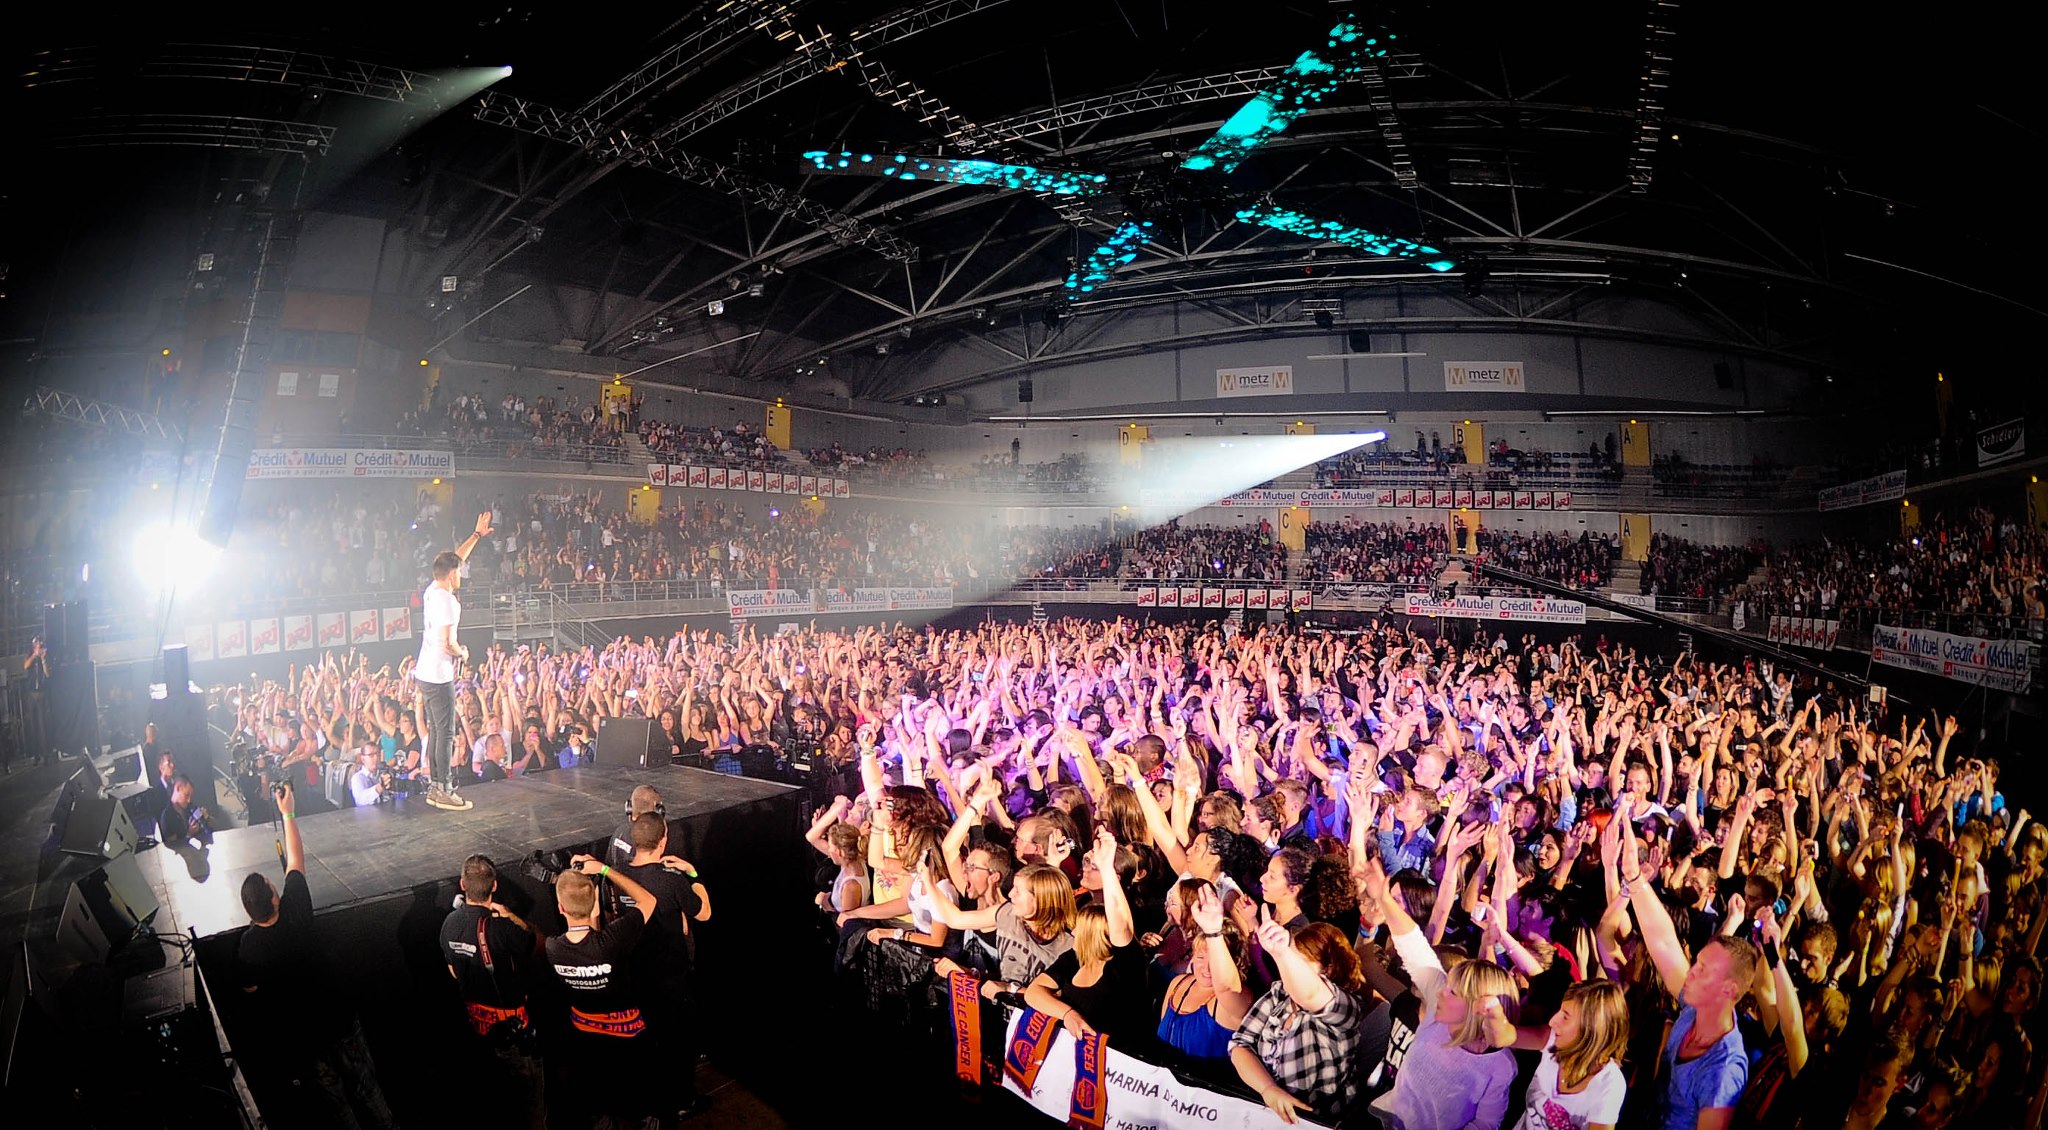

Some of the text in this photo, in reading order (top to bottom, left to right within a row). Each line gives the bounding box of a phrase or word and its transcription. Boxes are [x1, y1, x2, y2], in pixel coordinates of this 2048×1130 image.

[1240, 375, 1269, 384] metz
[1469, 370, 1499, 379] metz
[769, 410, 774, 426] E
[1122, 432, 1129, 446] D
[1457, 429, 1464, 443] B
[1624, 428, 1631, 444] A
[249, 452, 449, 467] Crédit Mutuel Crédit Mutuel
[1262, 492, 1295, 500] Mutuel
[1301, 491, 1330, 500] Crédit
[1342, 492, 1374, 500] Mutuel
[1282, 513, 1289, 528] C
[1624, 519, 1630, 536] A
[731, 593, 764, 606] Crédit
[777, 592, 811, 604] Mutuel
[856, 591, 885, 601] Mutuel
[890, 589, 915, 600] Crédit
[1410, 596, 1583, 614] Crédit Mutuel Crédit Mutuel
[1875, 628, 1898, 647] Crédit
[1943, 639, 1974, 663] Crédit
[1987, 648, 2027, 671] Mutuel
[957, 1004, 967, 1019] LE
[958, 1019, 971, 1066] CANCER
[1105, 1067, 1159, 1097] MARINA
